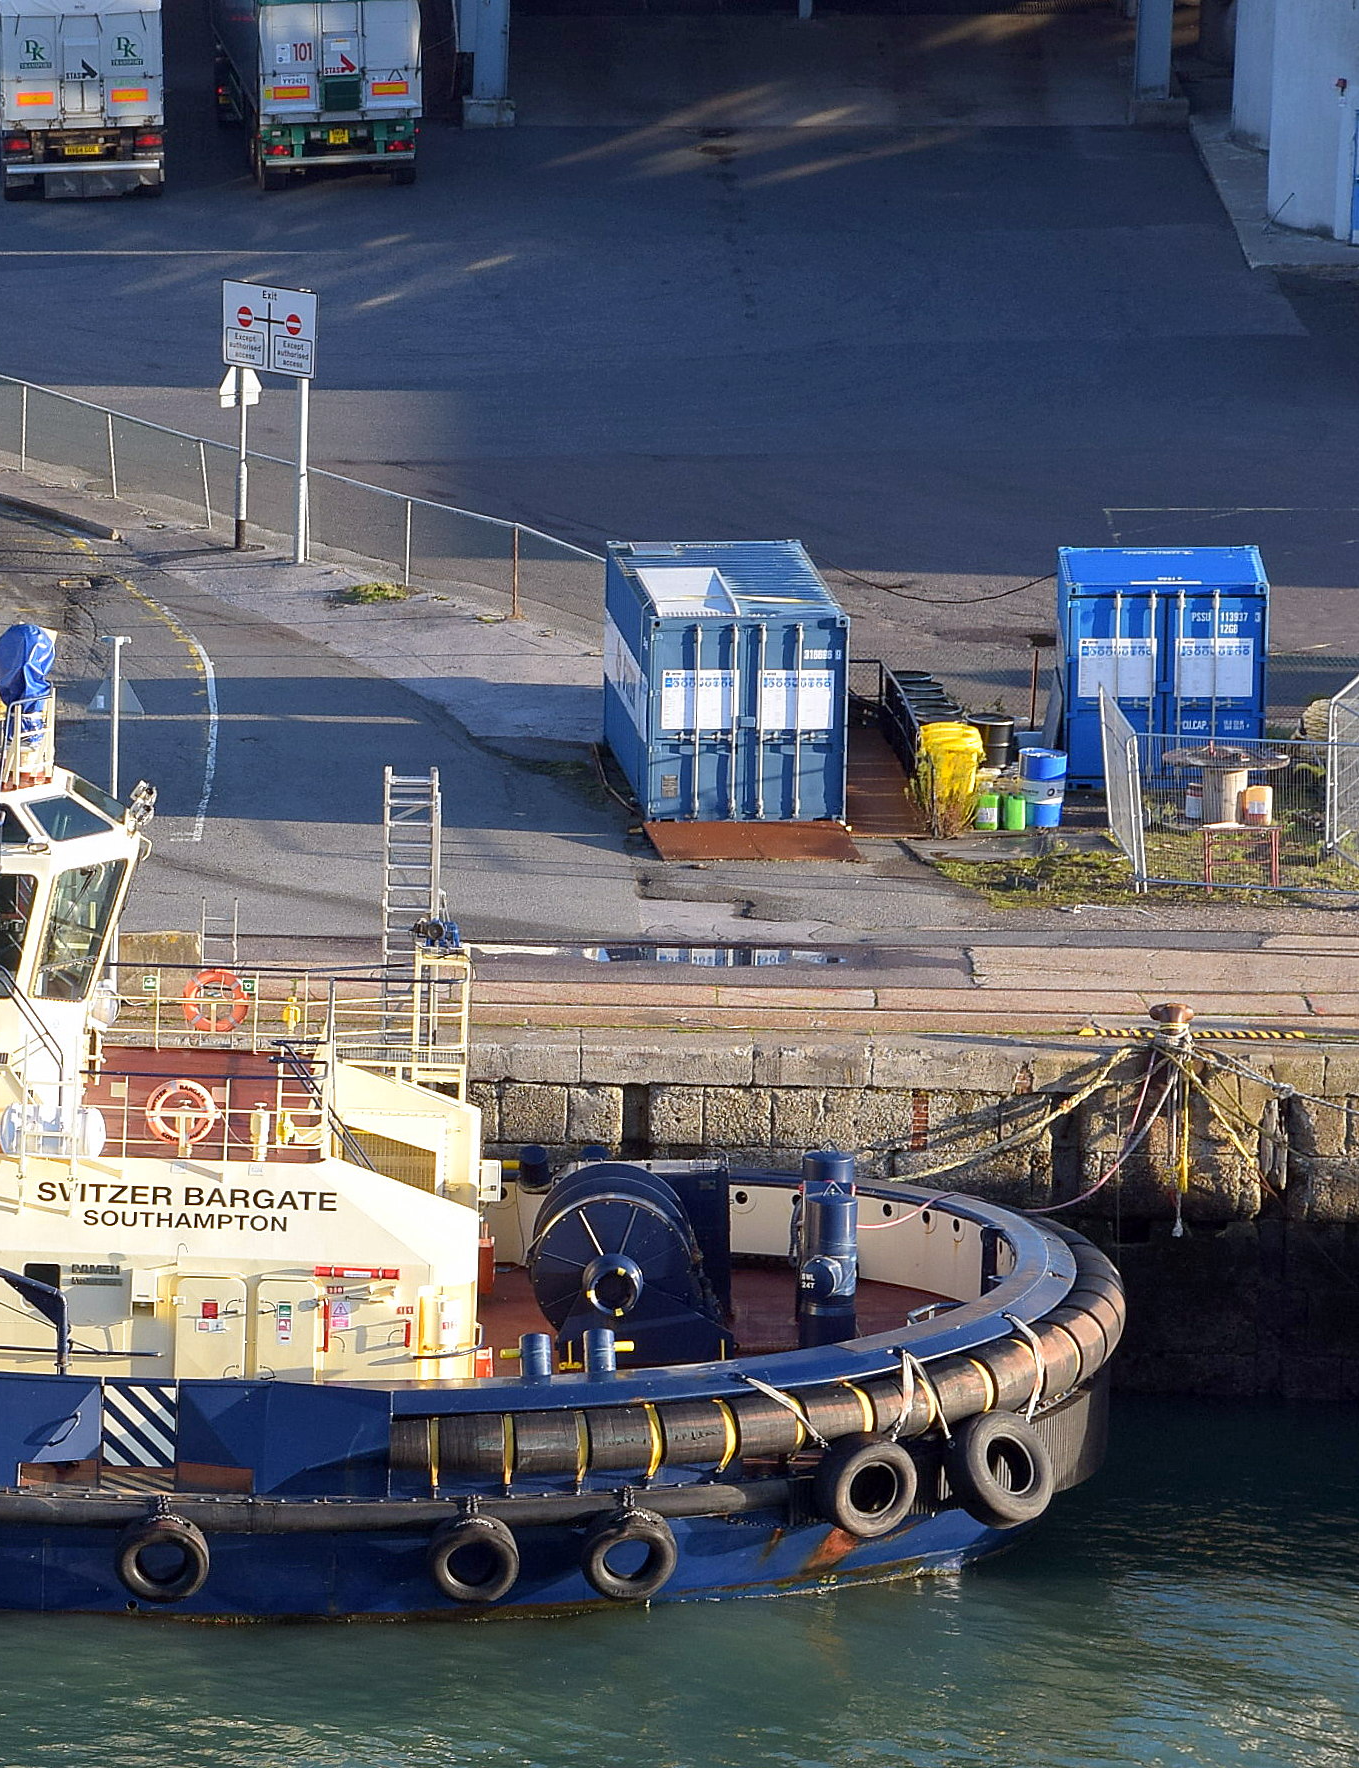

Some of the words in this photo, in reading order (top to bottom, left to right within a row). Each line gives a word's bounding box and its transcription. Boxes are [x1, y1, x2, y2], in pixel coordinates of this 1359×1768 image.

[293, 43, 313, 61] 101
[262, 290, 278, 301] Exit
[234, 332, 257, 344] Except
[229, 341, 262, 352] authorised
[283, 340, 304, 352] Except
[235, 351, 256, 360] access
[277, 350, 309, 360] authorised
[282, 359, 303, 368] access
[1191, 612, 1212, 622] PSSU
[1220, 612, 1249, 622] 113937
[36, 1181, 172, 1206] SVITZER
[184, 1186, 338, 1212] BARGATE
[83, 1209, 288, 1232] SOUTHAMPTON
